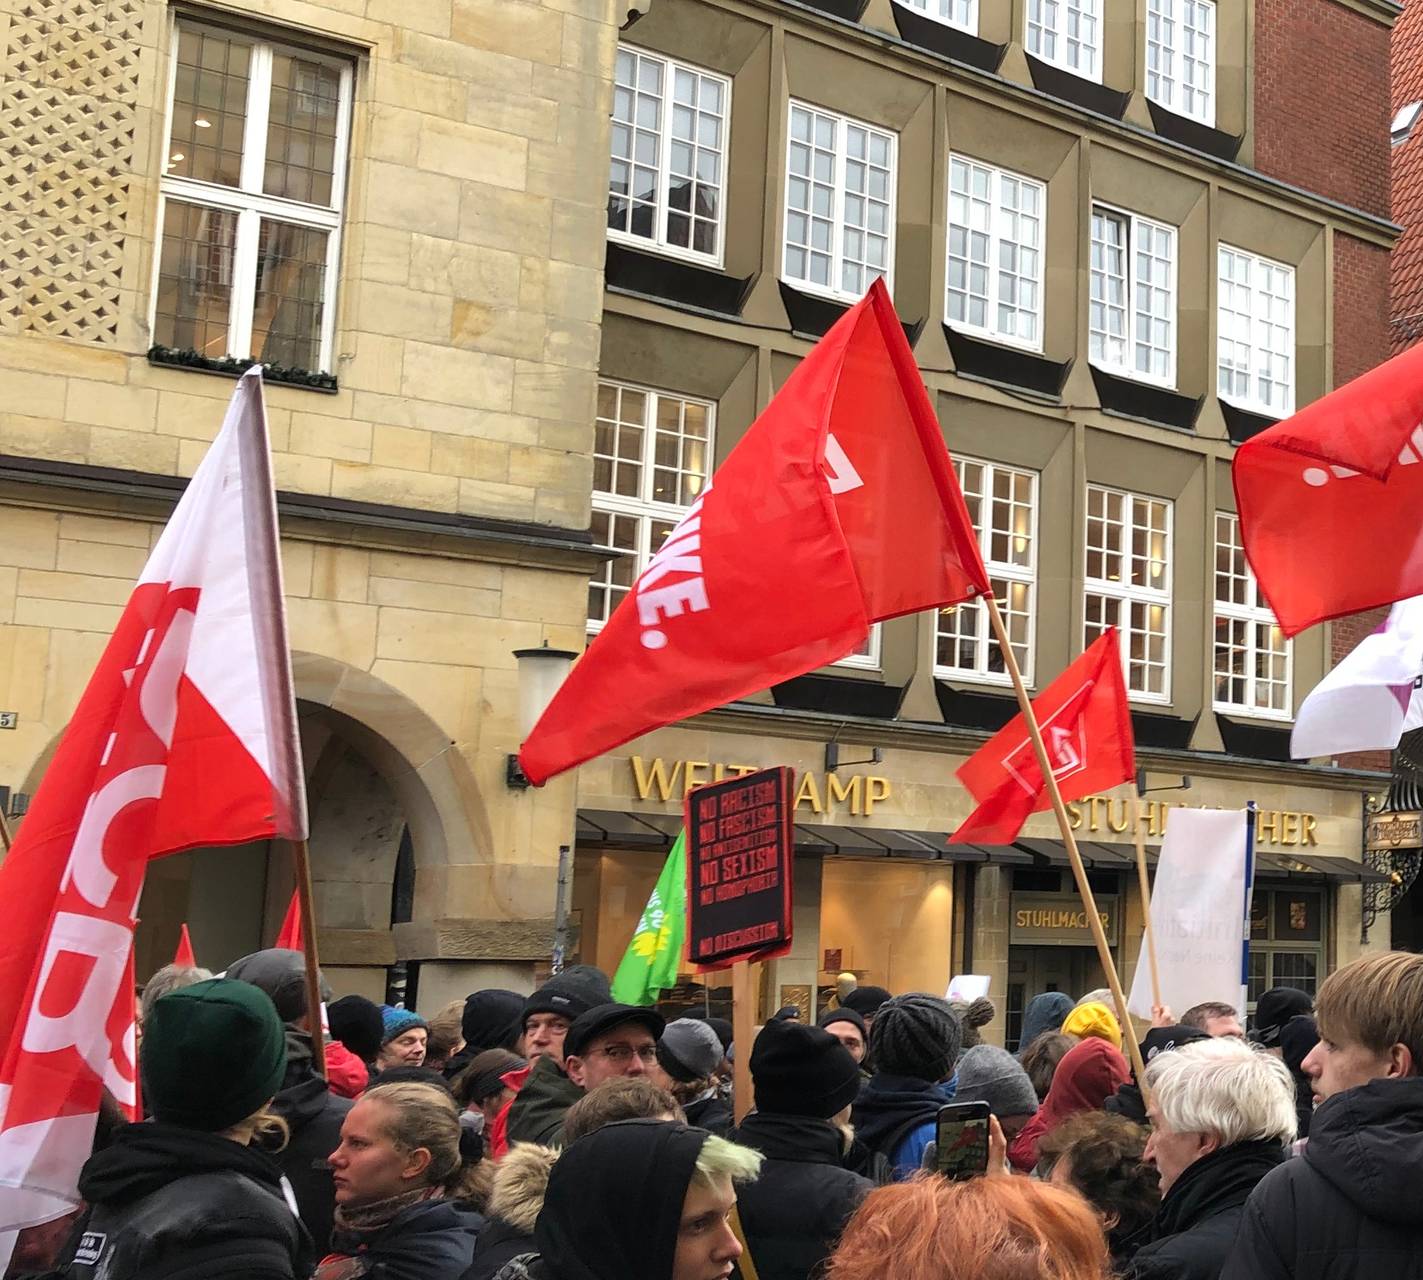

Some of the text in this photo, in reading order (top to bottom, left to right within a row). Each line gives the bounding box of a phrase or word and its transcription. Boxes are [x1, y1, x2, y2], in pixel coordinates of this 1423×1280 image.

[699, 796, 718, 820] NO
[699, 820, 717, 844] NO
[700, 844, 778, 887] NO SEXISM
